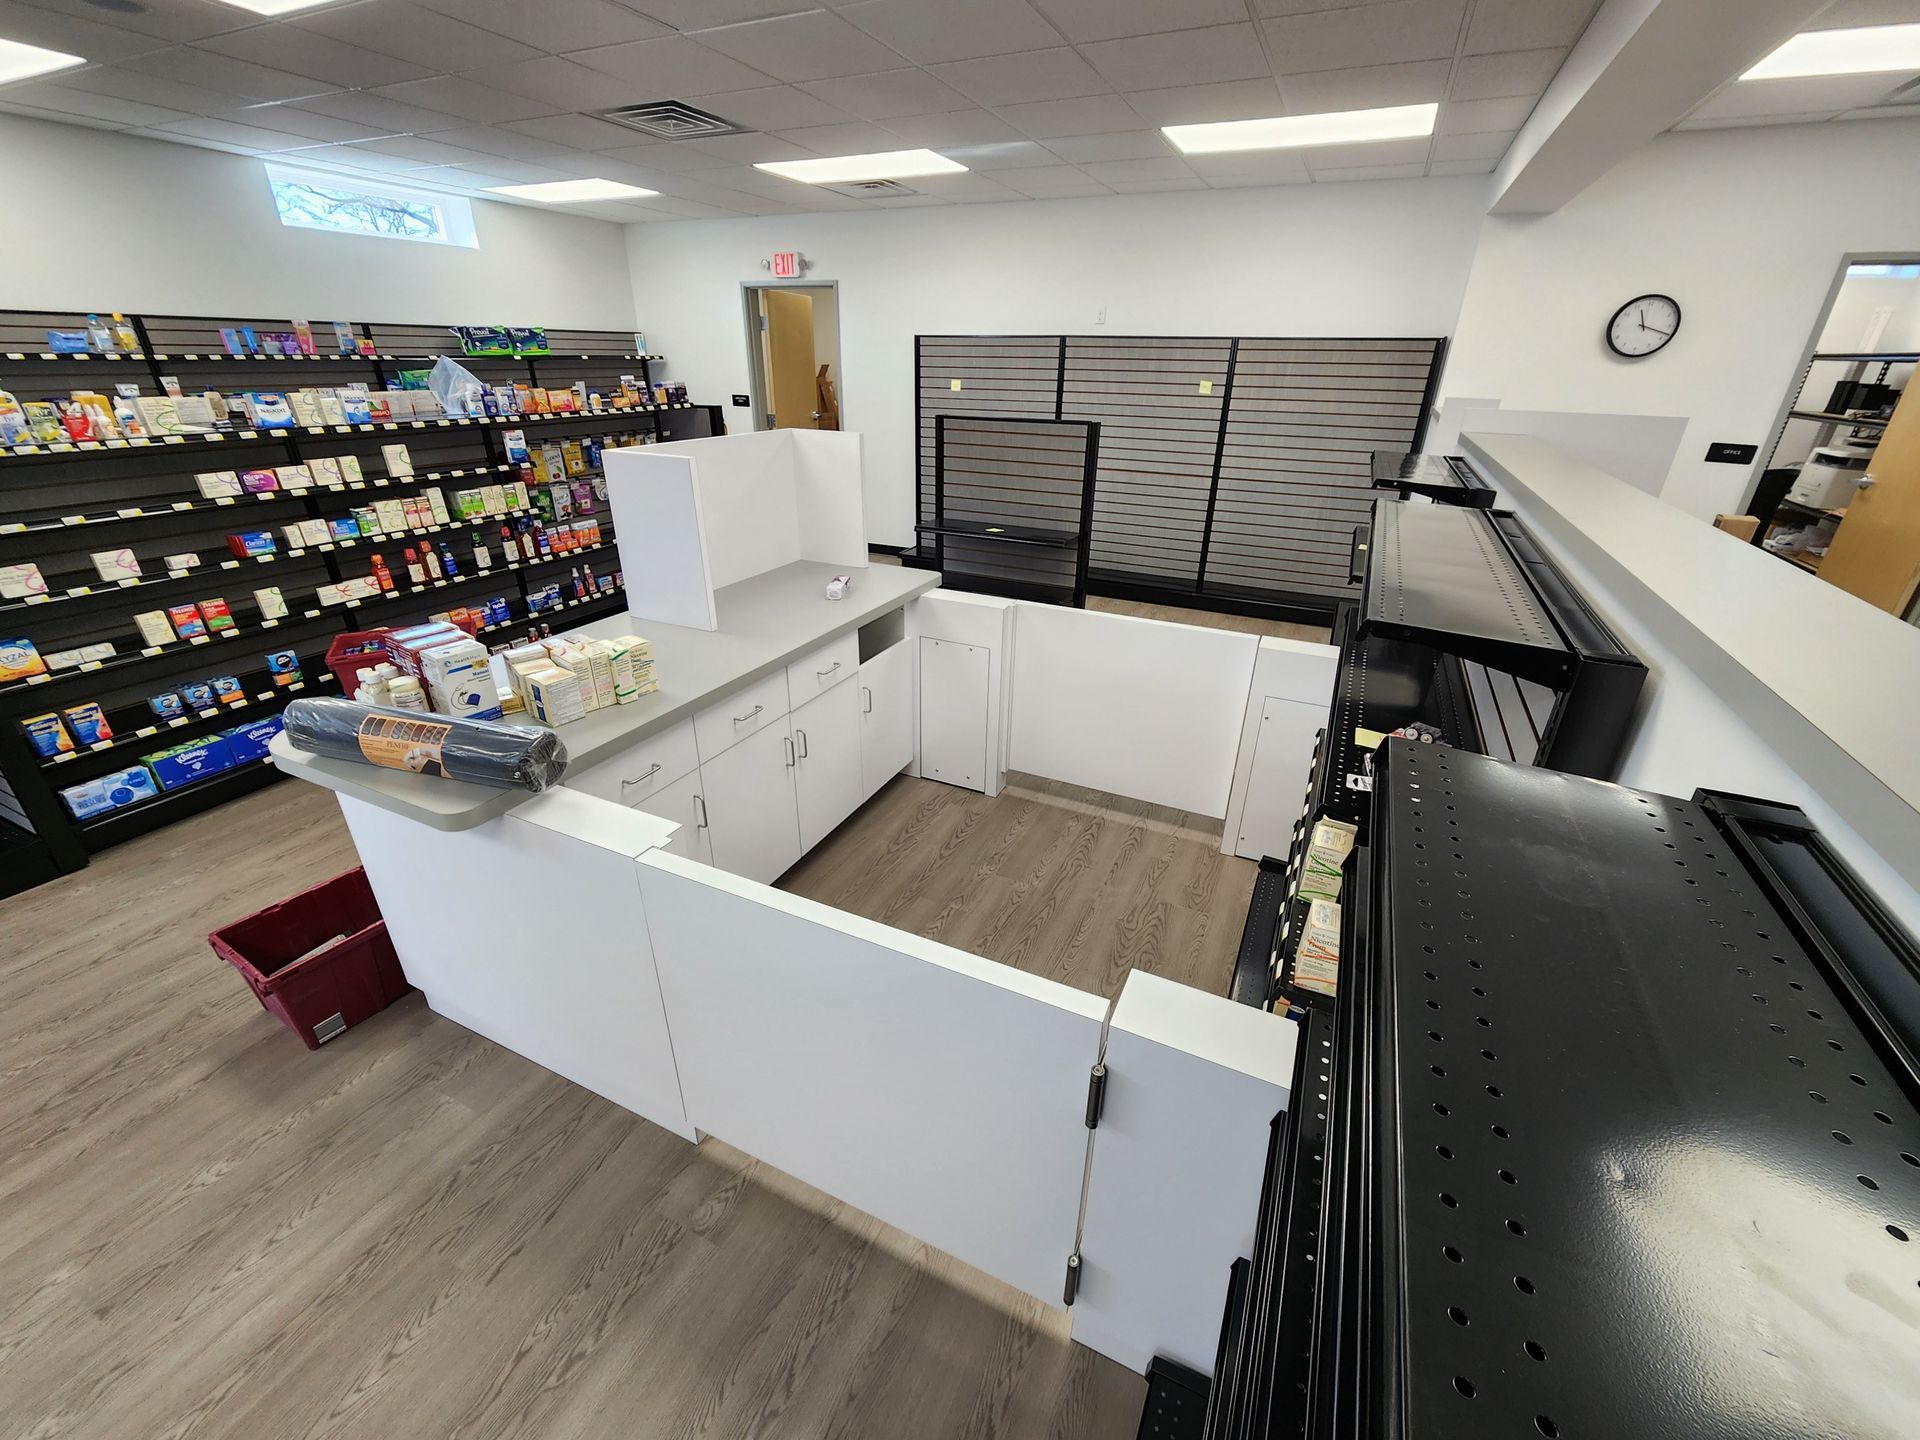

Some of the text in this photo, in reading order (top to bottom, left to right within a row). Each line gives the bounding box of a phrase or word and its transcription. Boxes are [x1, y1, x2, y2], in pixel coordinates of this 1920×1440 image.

[774, 253, 794, 275] EXIT
[247, 726, 277, 740] Kleenex
[174, 749, 209, 764] Kleenex
